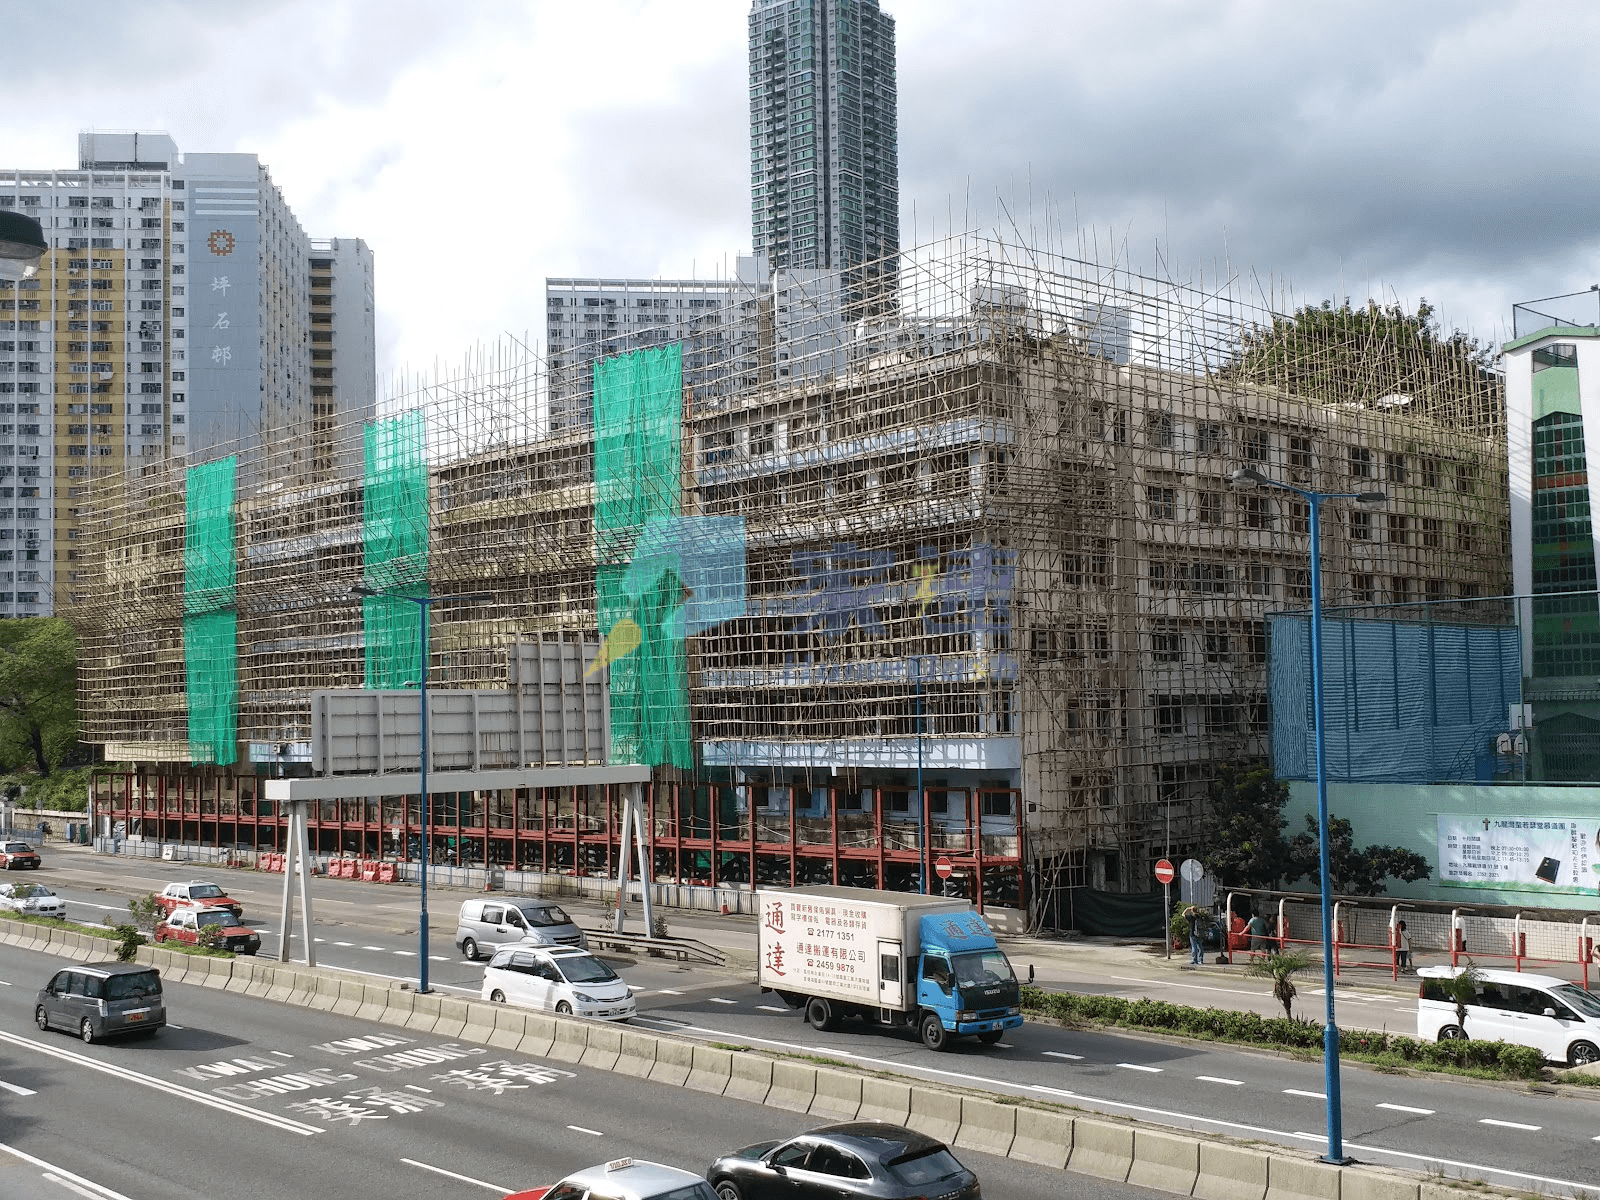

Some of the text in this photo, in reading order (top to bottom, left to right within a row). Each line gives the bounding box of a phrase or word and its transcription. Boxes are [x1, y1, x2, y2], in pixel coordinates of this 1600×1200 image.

[210, 276, 232, 366] 坪石邨
[765, 901, 787, 977] 通達
[816, 928, 855, 942] 2177 1351
[796, 941, 866, 963] 通達搬運有限公司
[816, 959, 855, 974] 2459 9878
[310, 1032, 419, 1056] KWAI
[174, 1055, 288, 1081] KWAI
[352, 1043, 487, 1073] CHUNG
[211, 1067, 358, 1101] CHUNG
